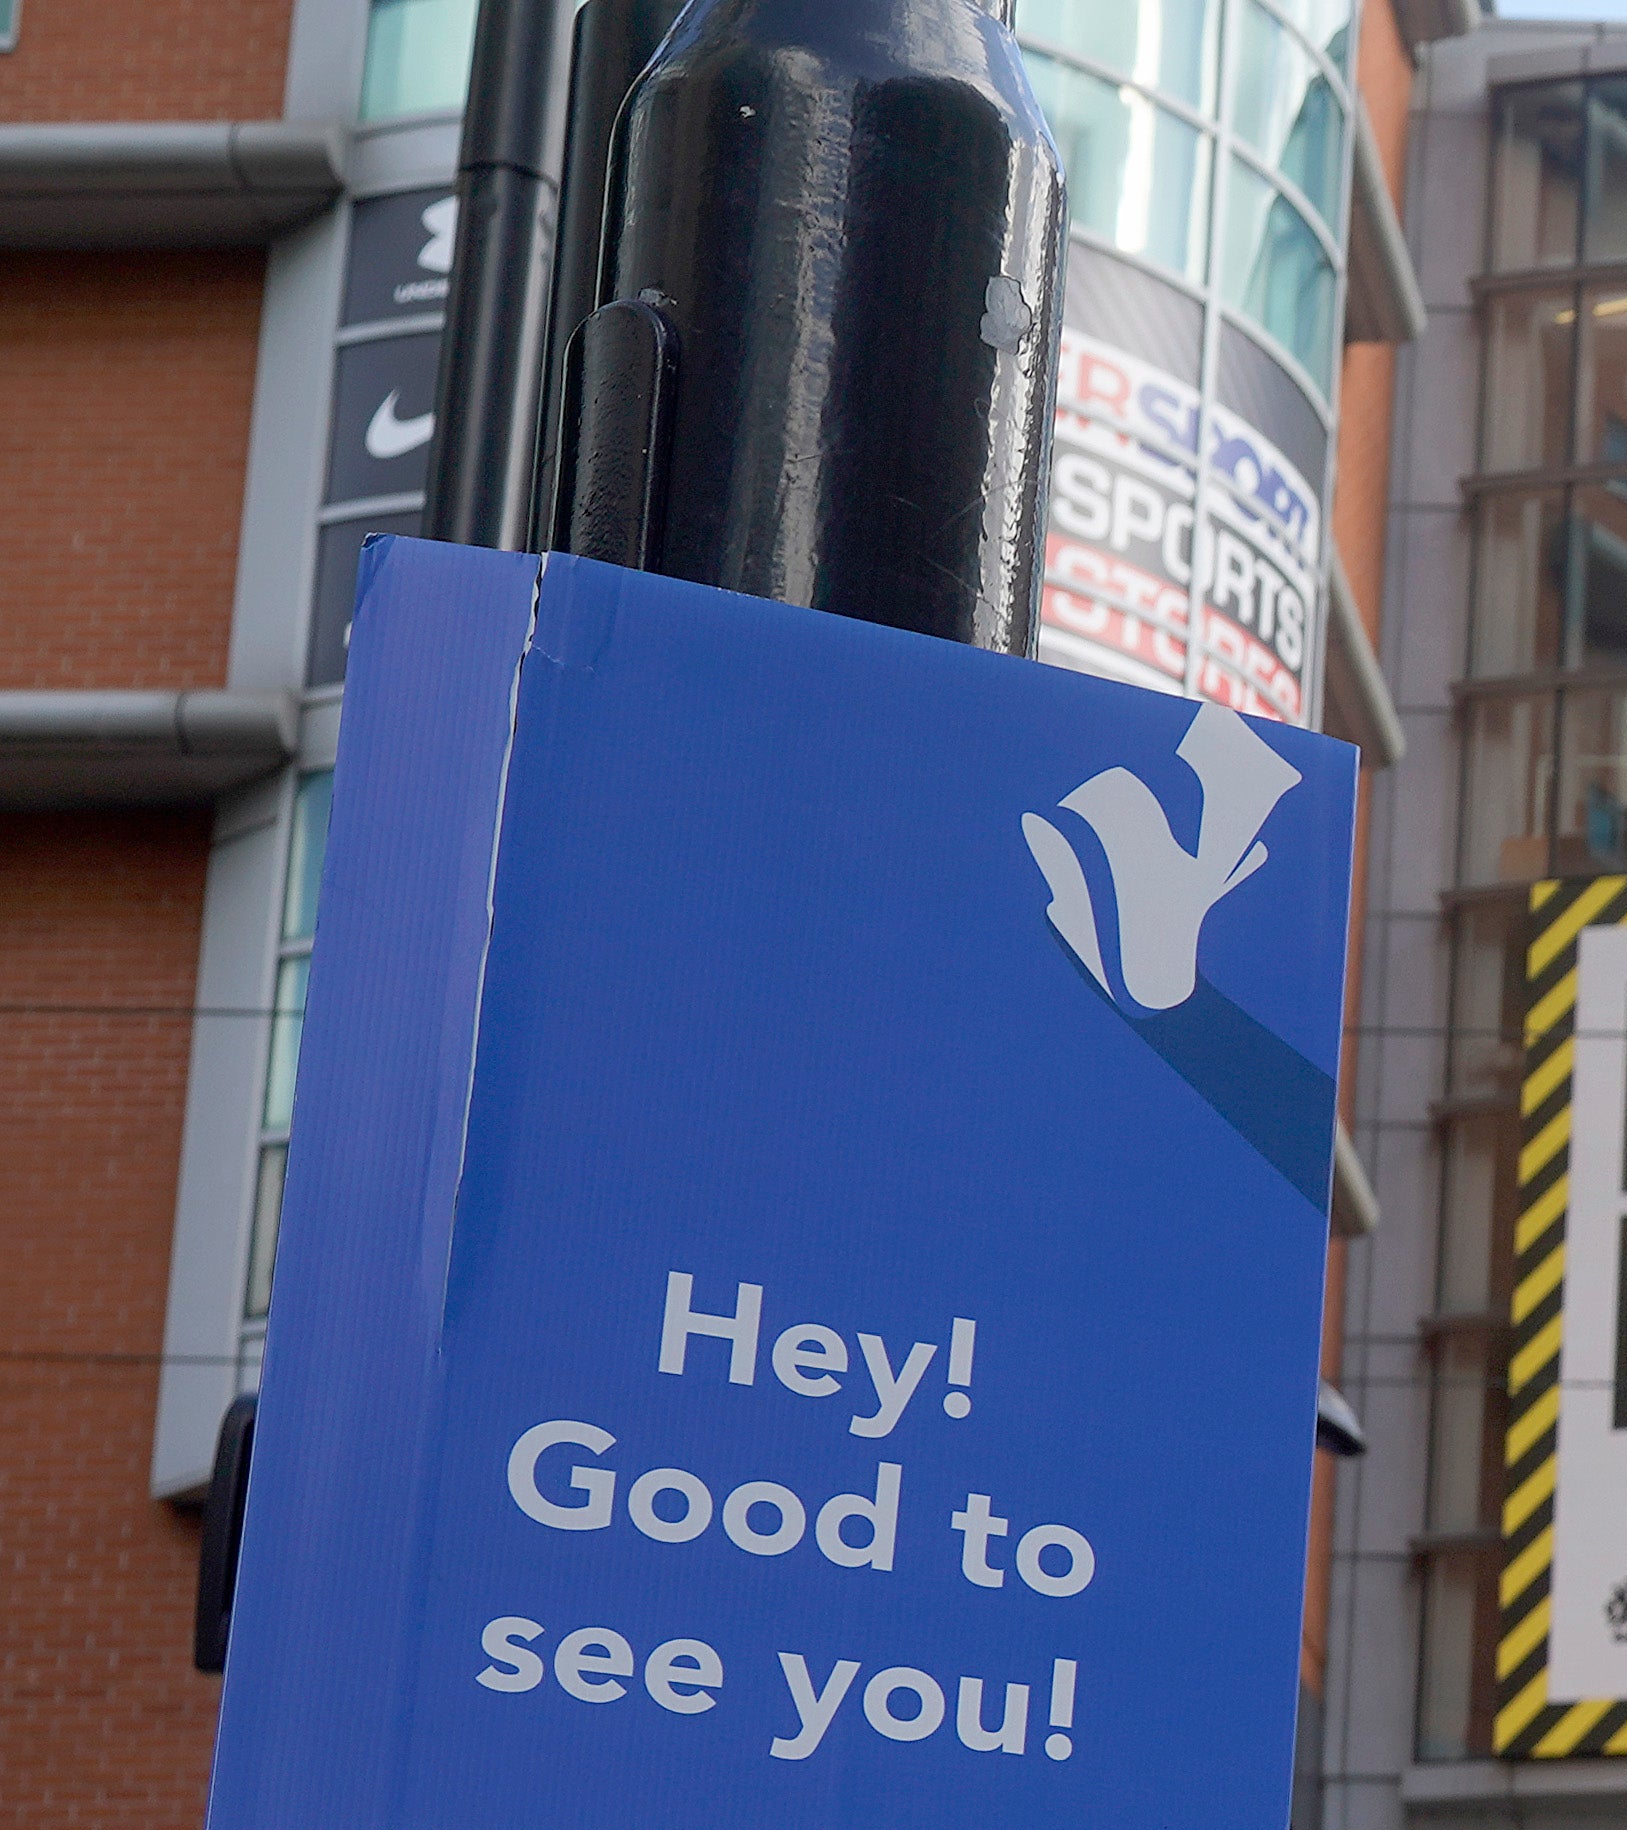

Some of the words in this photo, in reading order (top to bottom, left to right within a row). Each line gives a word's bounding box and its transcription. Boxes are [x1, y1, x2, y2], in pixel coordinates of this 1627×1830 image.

[1052, 452, 1303, 673] SPORTS
[658, 1271, 976, 1438] Hey!
[506, 1419, 903, 1572] Good
[950, 1492, 1096, 1598] to
[475, 1616, 724, 1715] see
[769, 1652, 1078, 1761] you!
